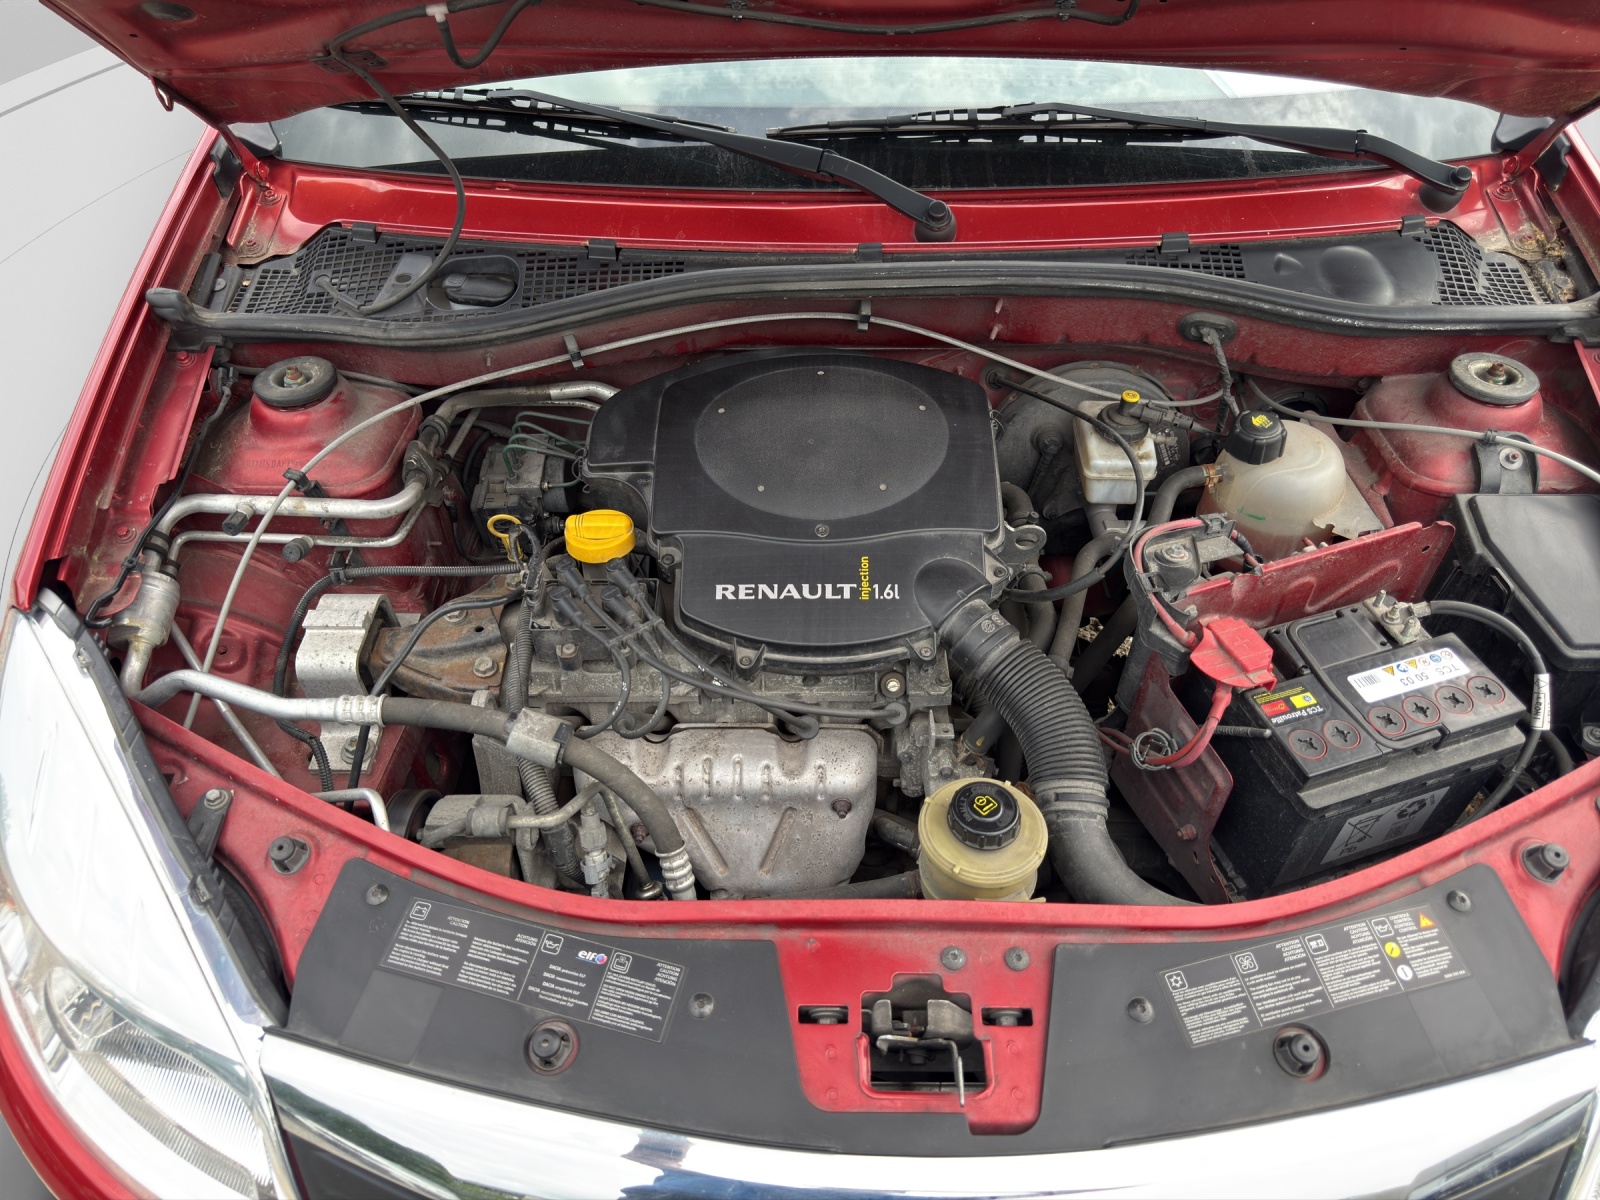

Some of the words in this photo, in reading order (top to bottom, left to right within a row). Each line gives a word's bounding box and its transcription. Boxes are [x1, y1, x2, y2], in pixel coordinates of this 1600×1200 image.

[859, 556, 871, 600] injection
[715, 583, 857, 600] RENAULT
[1436, 663, 1460, 676] TCS
[1400, 676, 1415, 686] 03
[1414, 671, 1430, 681] 50
[1307, 704, 1324, 713] TCS
[1271, 707, 1308, 723] Patrouille
[1338, 846, 1357, 856] Pb
[1344, 922, 1366, 931] ATTENTION
[1276, 939, 1300, 949] ATTENTION
[1282, 943, 1302, 951] CAUTION
[578, 950, 597, 961] elf
[1283, 948, 1304, 957] ACHTUNG
[656, 963, 680, 972] ATTENTION
[659, 968, 679, 976] CAUTION
[656, 972, 677, 981] ACHTUNG
